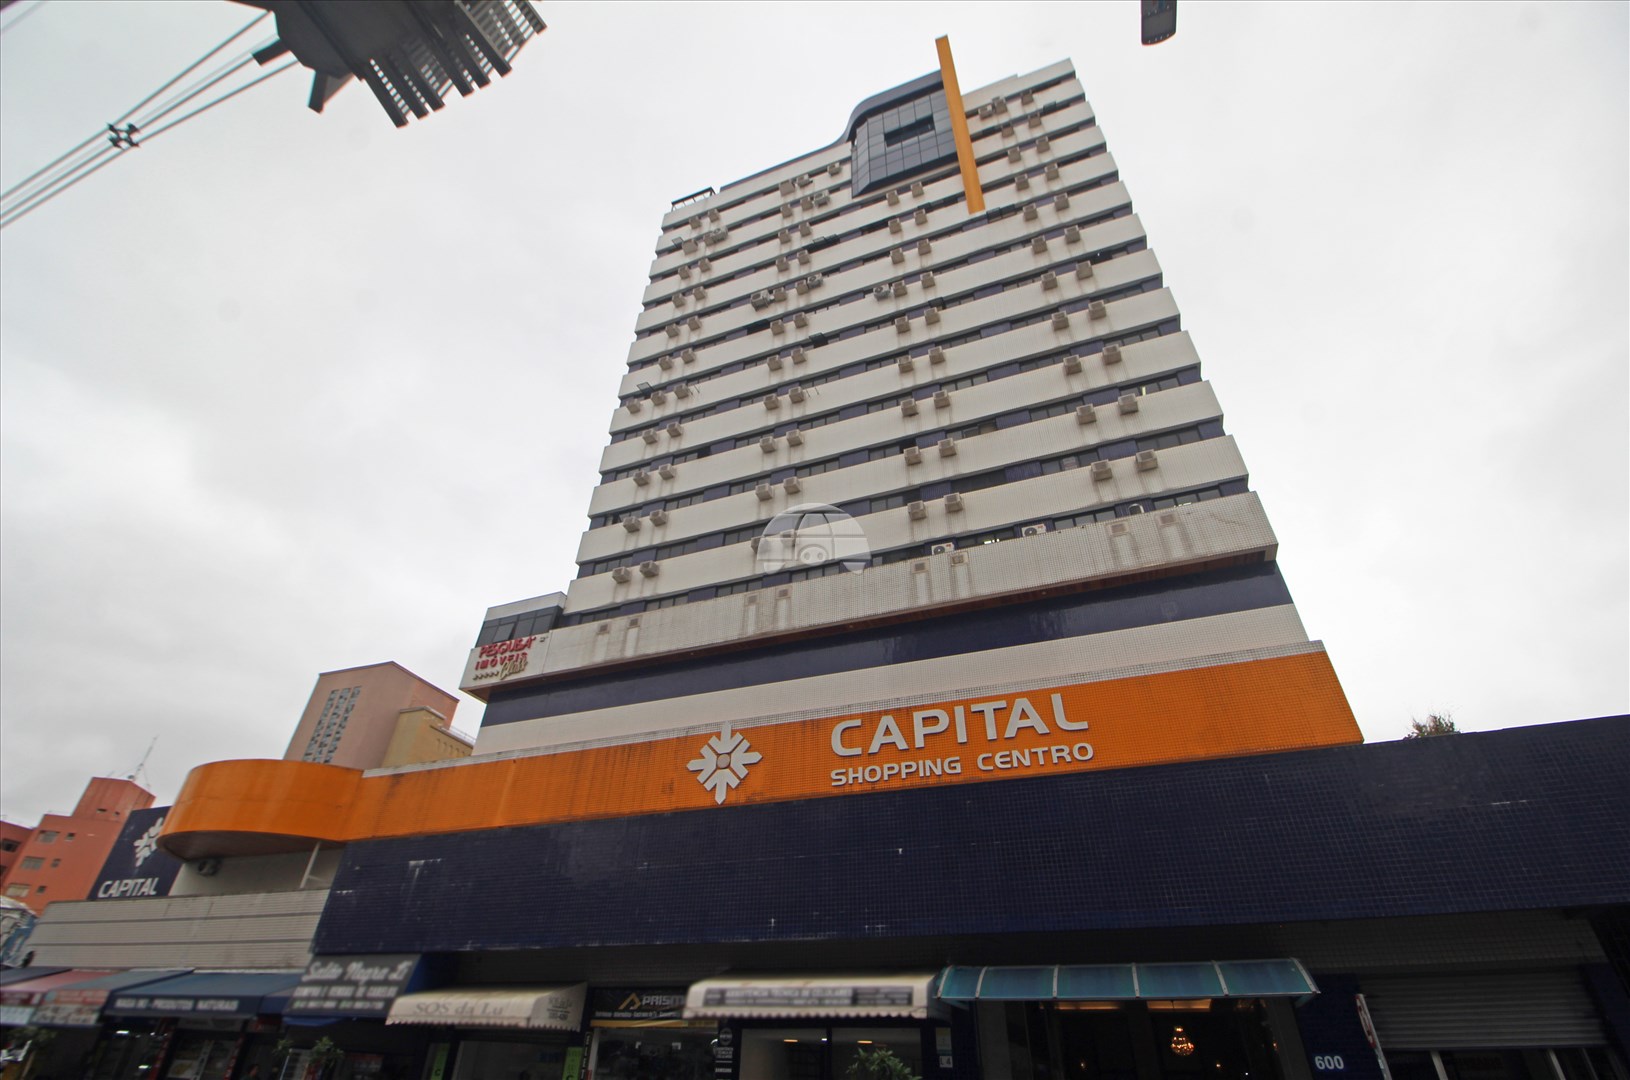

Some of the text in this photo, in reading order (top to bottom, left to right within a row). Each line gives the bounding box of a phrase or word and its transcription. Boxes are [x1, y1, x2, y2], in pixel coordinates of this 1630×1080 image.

[831, 693, 1089, 756] CAPITAL
[830, 742, 1095, 787] SHOPPING CENTRO
[97, 877, 159, 898] CAPITAL
[415, 1001, 449, 1015] SOS
[642, 995, 686, 1006] PRISM
[1315, 1055, 1344, 1070] 600
